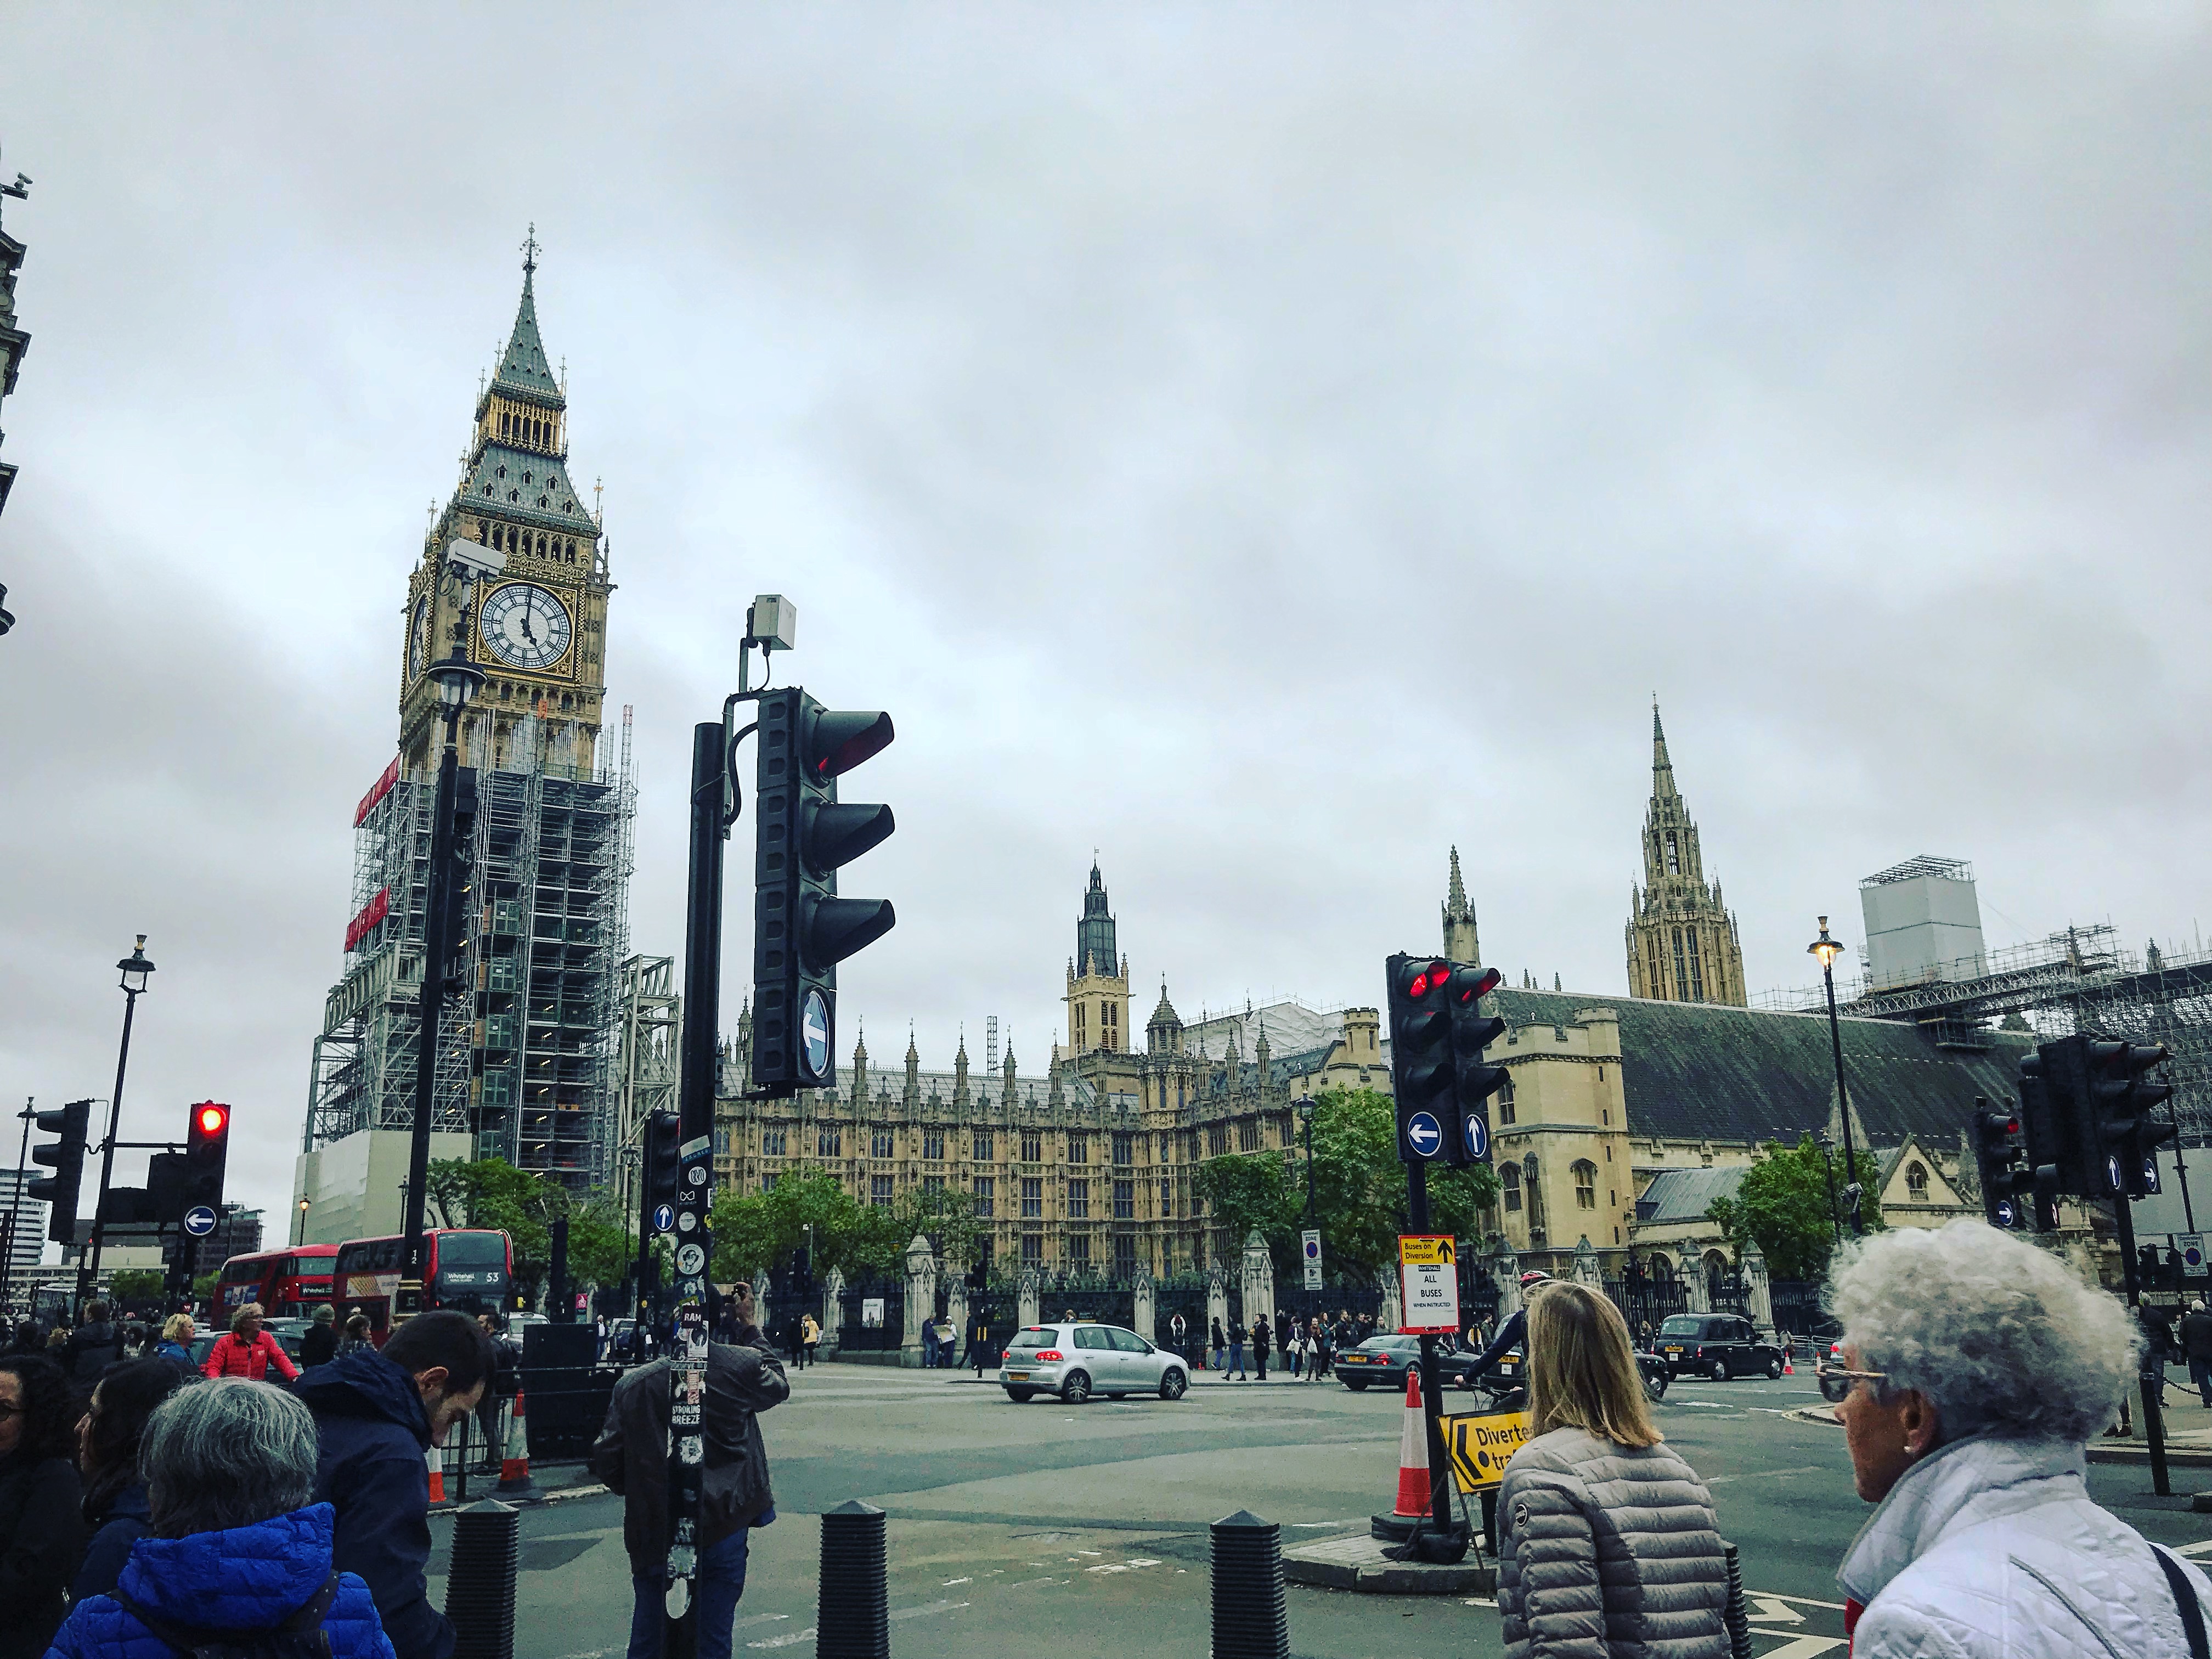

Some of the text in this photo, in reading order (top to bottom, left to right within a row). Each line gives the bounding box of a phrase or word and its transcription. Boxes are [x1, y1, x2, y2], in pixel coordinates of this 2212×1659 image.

[486, 1272, 499, 1283] 53
[1421, 1289, 1442, 1297] BUSES
[684, 1313, 702, 1322] RAM
[672, 1414, 700, 1425] BREEZE
